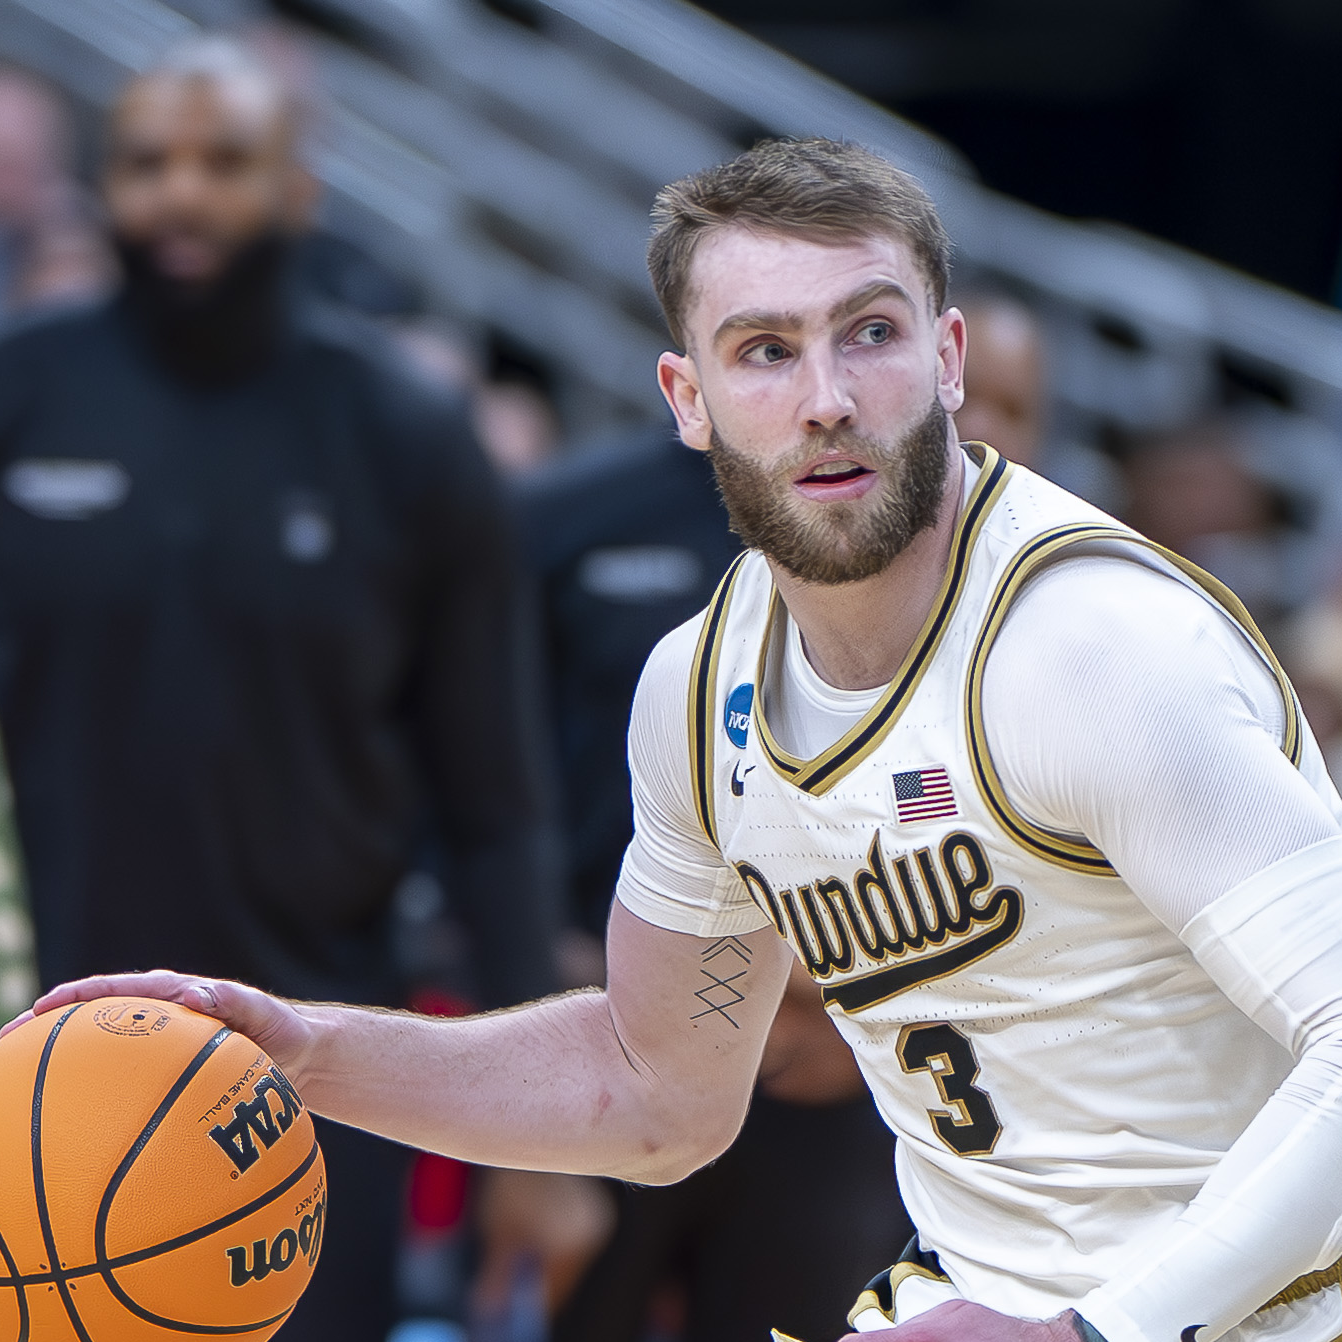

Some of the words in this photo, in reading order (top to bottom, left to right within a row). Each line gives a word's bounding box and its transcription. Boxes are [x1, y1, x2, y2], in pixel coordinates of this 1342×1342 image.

[728, 711, 751, 731] NC
[198, 1094, 232, 1124] BALL
[895, 1021, 1004, 1157] 3
[225, 1188, 327, 1288] lson
